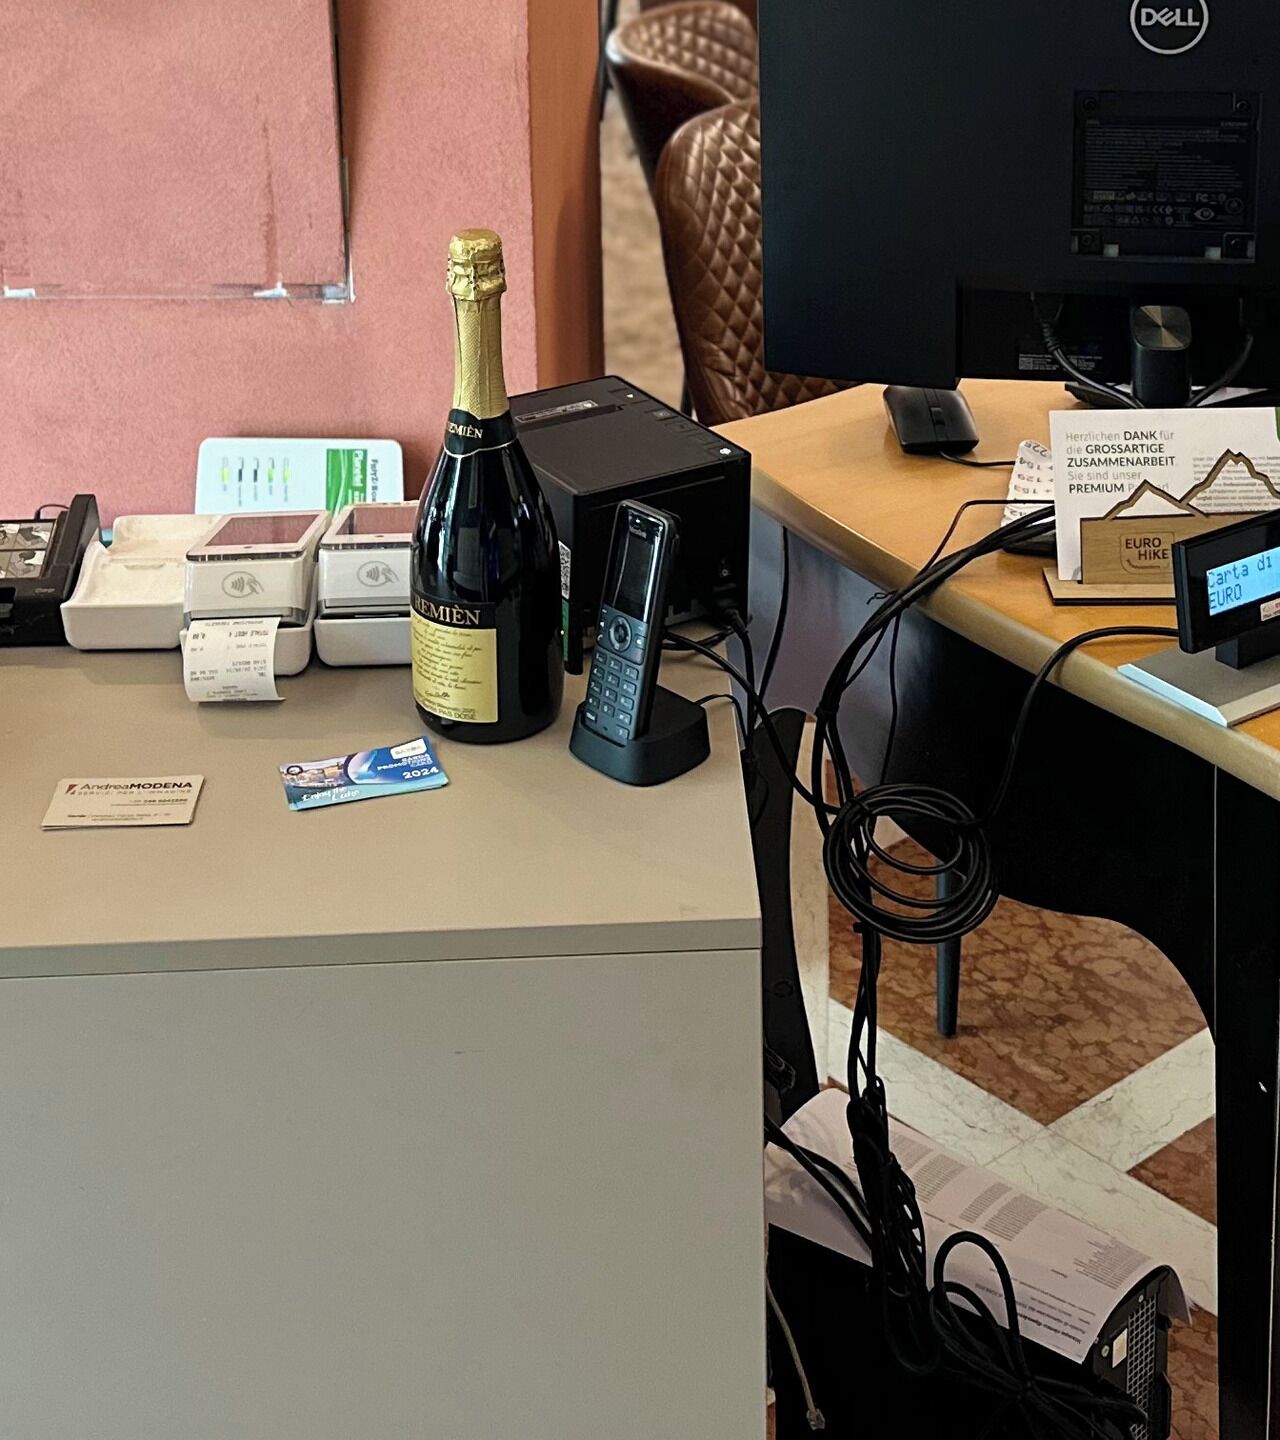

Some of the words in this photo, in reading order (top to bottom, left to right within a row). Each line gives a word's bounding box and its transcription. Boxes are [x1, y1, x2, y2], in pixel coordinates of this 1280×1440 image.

[1140, 7, 1200, 27] DELL
[1065, 431, 1121, 443] Herzlichen
[1123, 430, 1158, 441] DANK
[1159, 430, 1175, 441] für
[1066, 444, 1083, 455] die
[1085, 443, 1165, 455] GROSSARTIGE
[1067, 455, 1176, 468] ZUSAMMENARBEIT
[1067, 471, 1085, 482] Sie
[1087, 470, 1109, 481] sind
[1111, 470, 1142, 480] unser
[1069, 483, 1125, 494] PREMIUM
[1125, 537, 1162, 550] EURO
[1138, 548, 1169, 561] HIKE
[1207, 564, 1249, 588] Carta
[1256, 554, 1272, 572] di
[1208, 583, 1243, 610] EURO
[402, 767, 440, 780] 2024
[80, 782, 193, 790] AndreaMODENA
